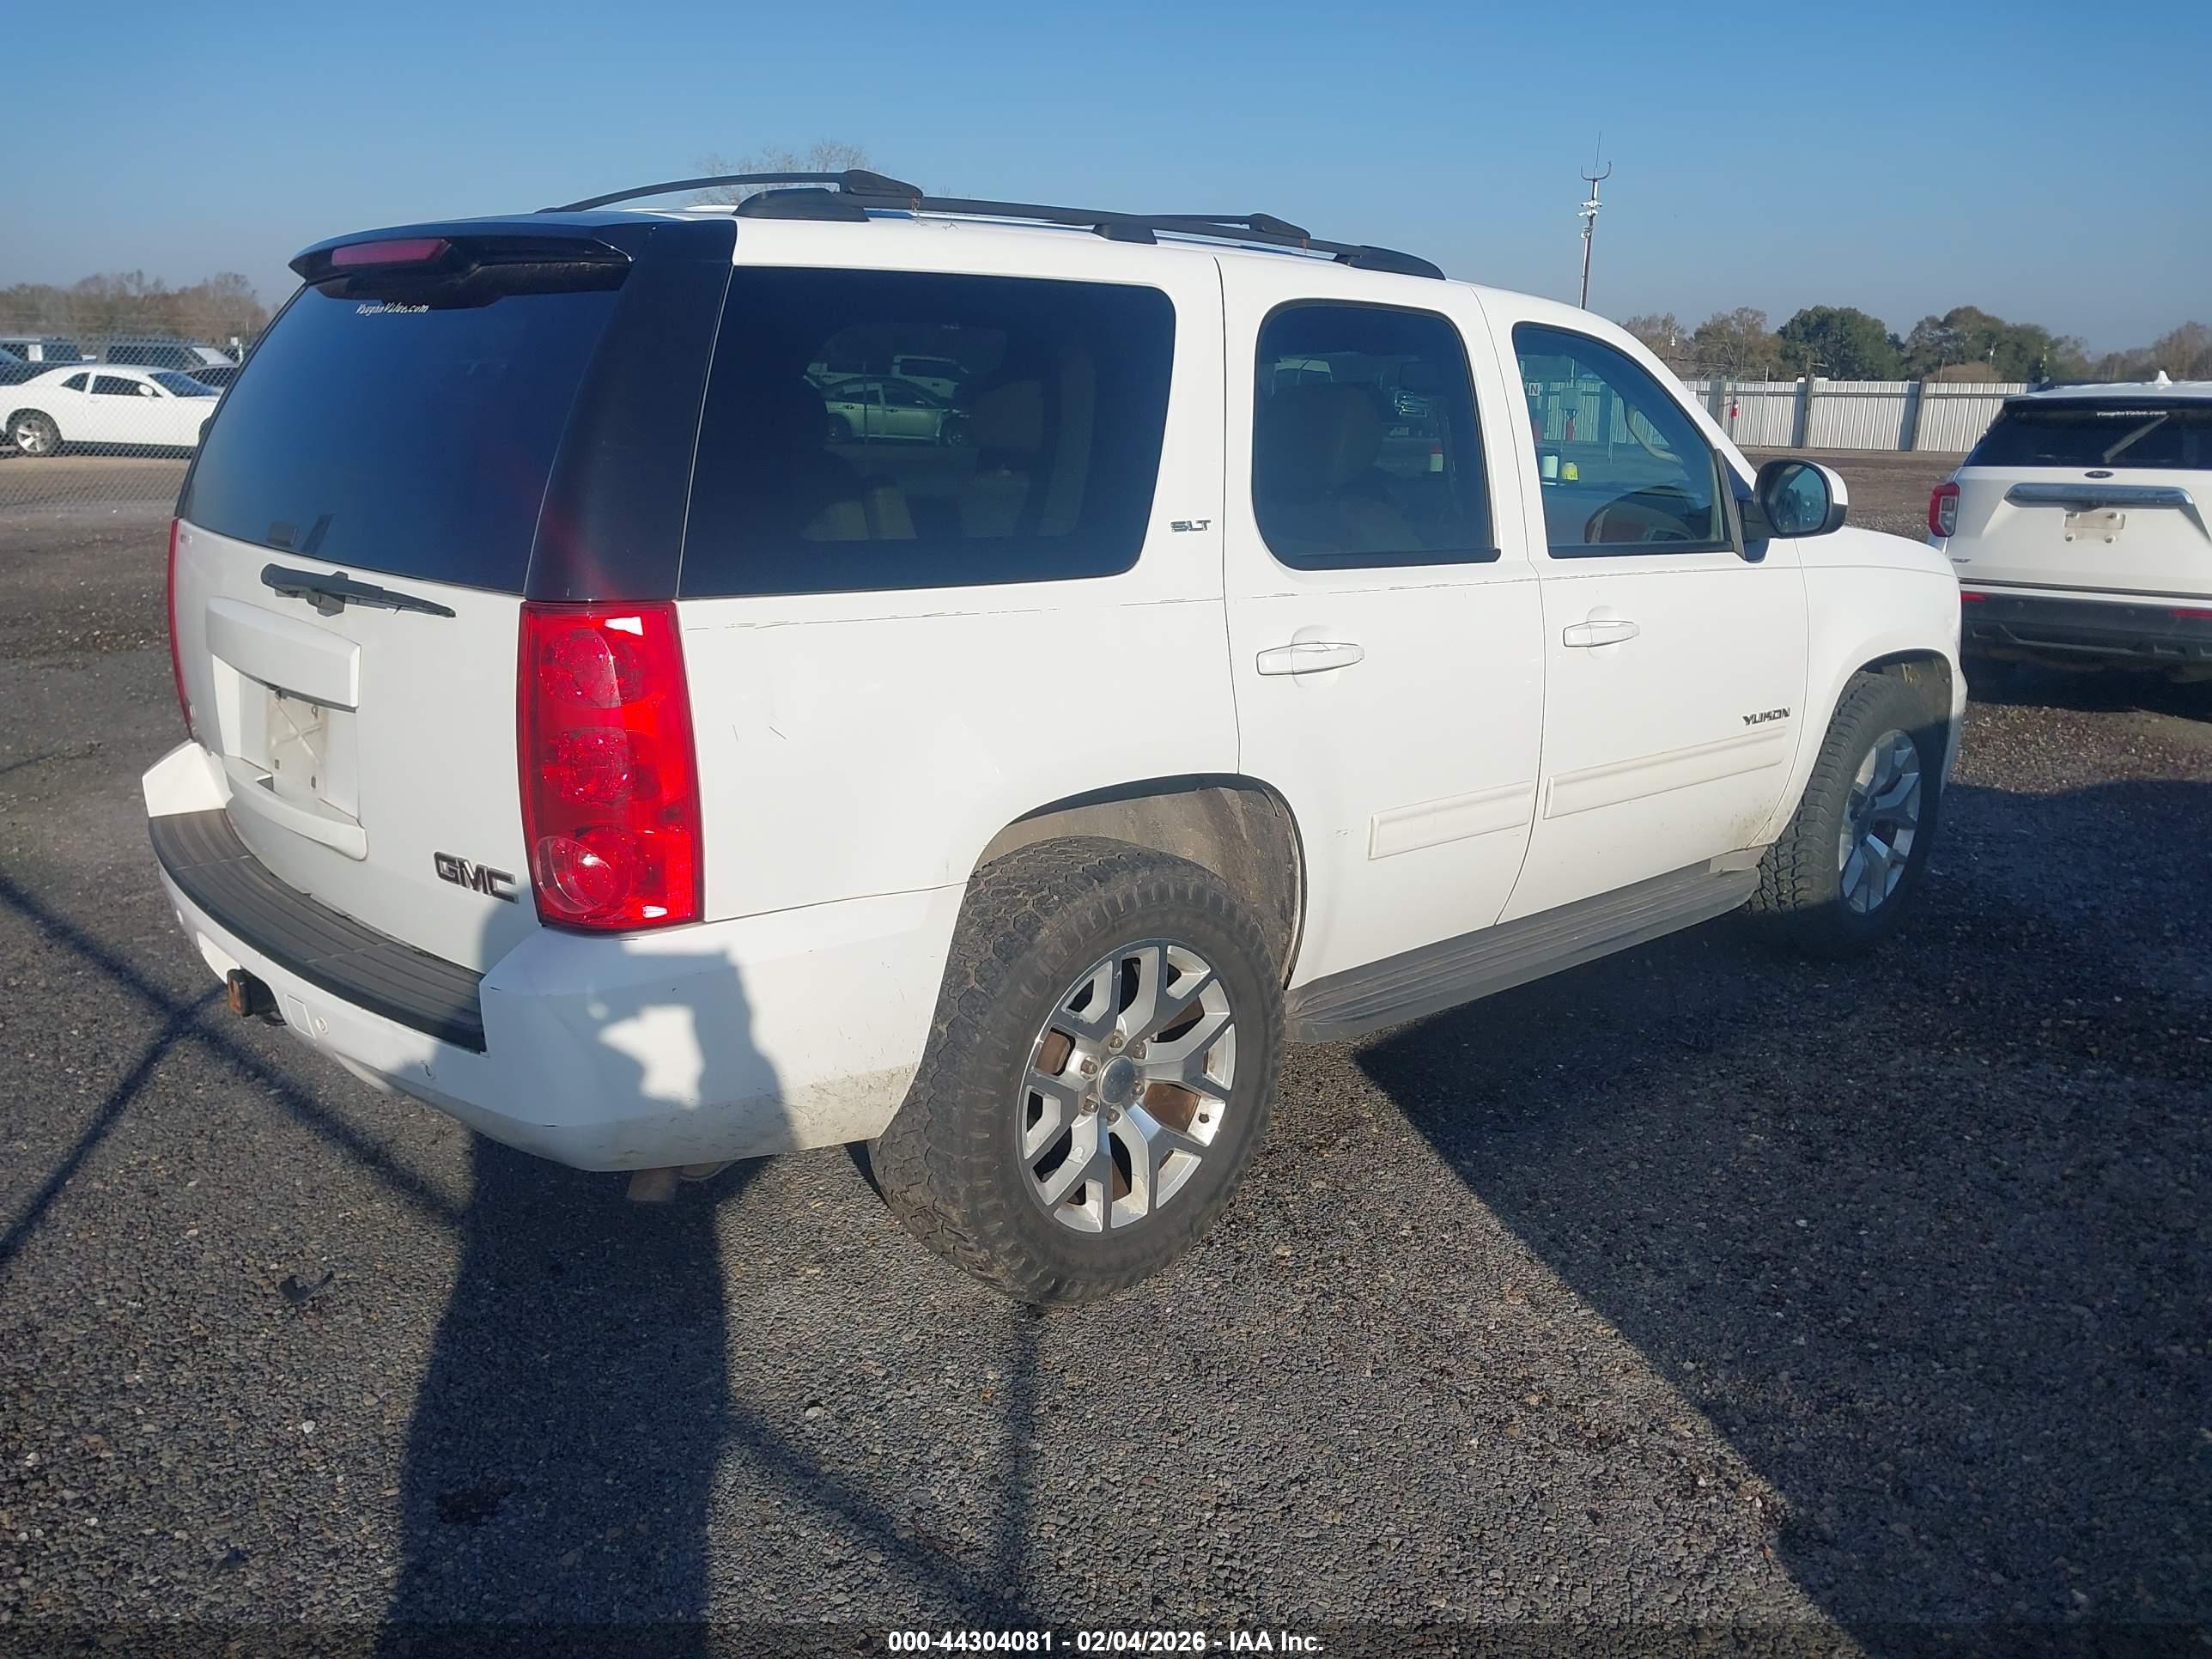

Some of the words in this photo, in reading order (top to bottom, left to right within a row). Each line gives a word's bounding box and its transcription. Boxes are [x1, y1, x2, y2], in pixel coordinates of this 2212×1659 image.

[1170, 520, 1212, 532] SLT
[1742, 707, 1791, 726] YUKON
[434, 851, 519, 904] GMC
